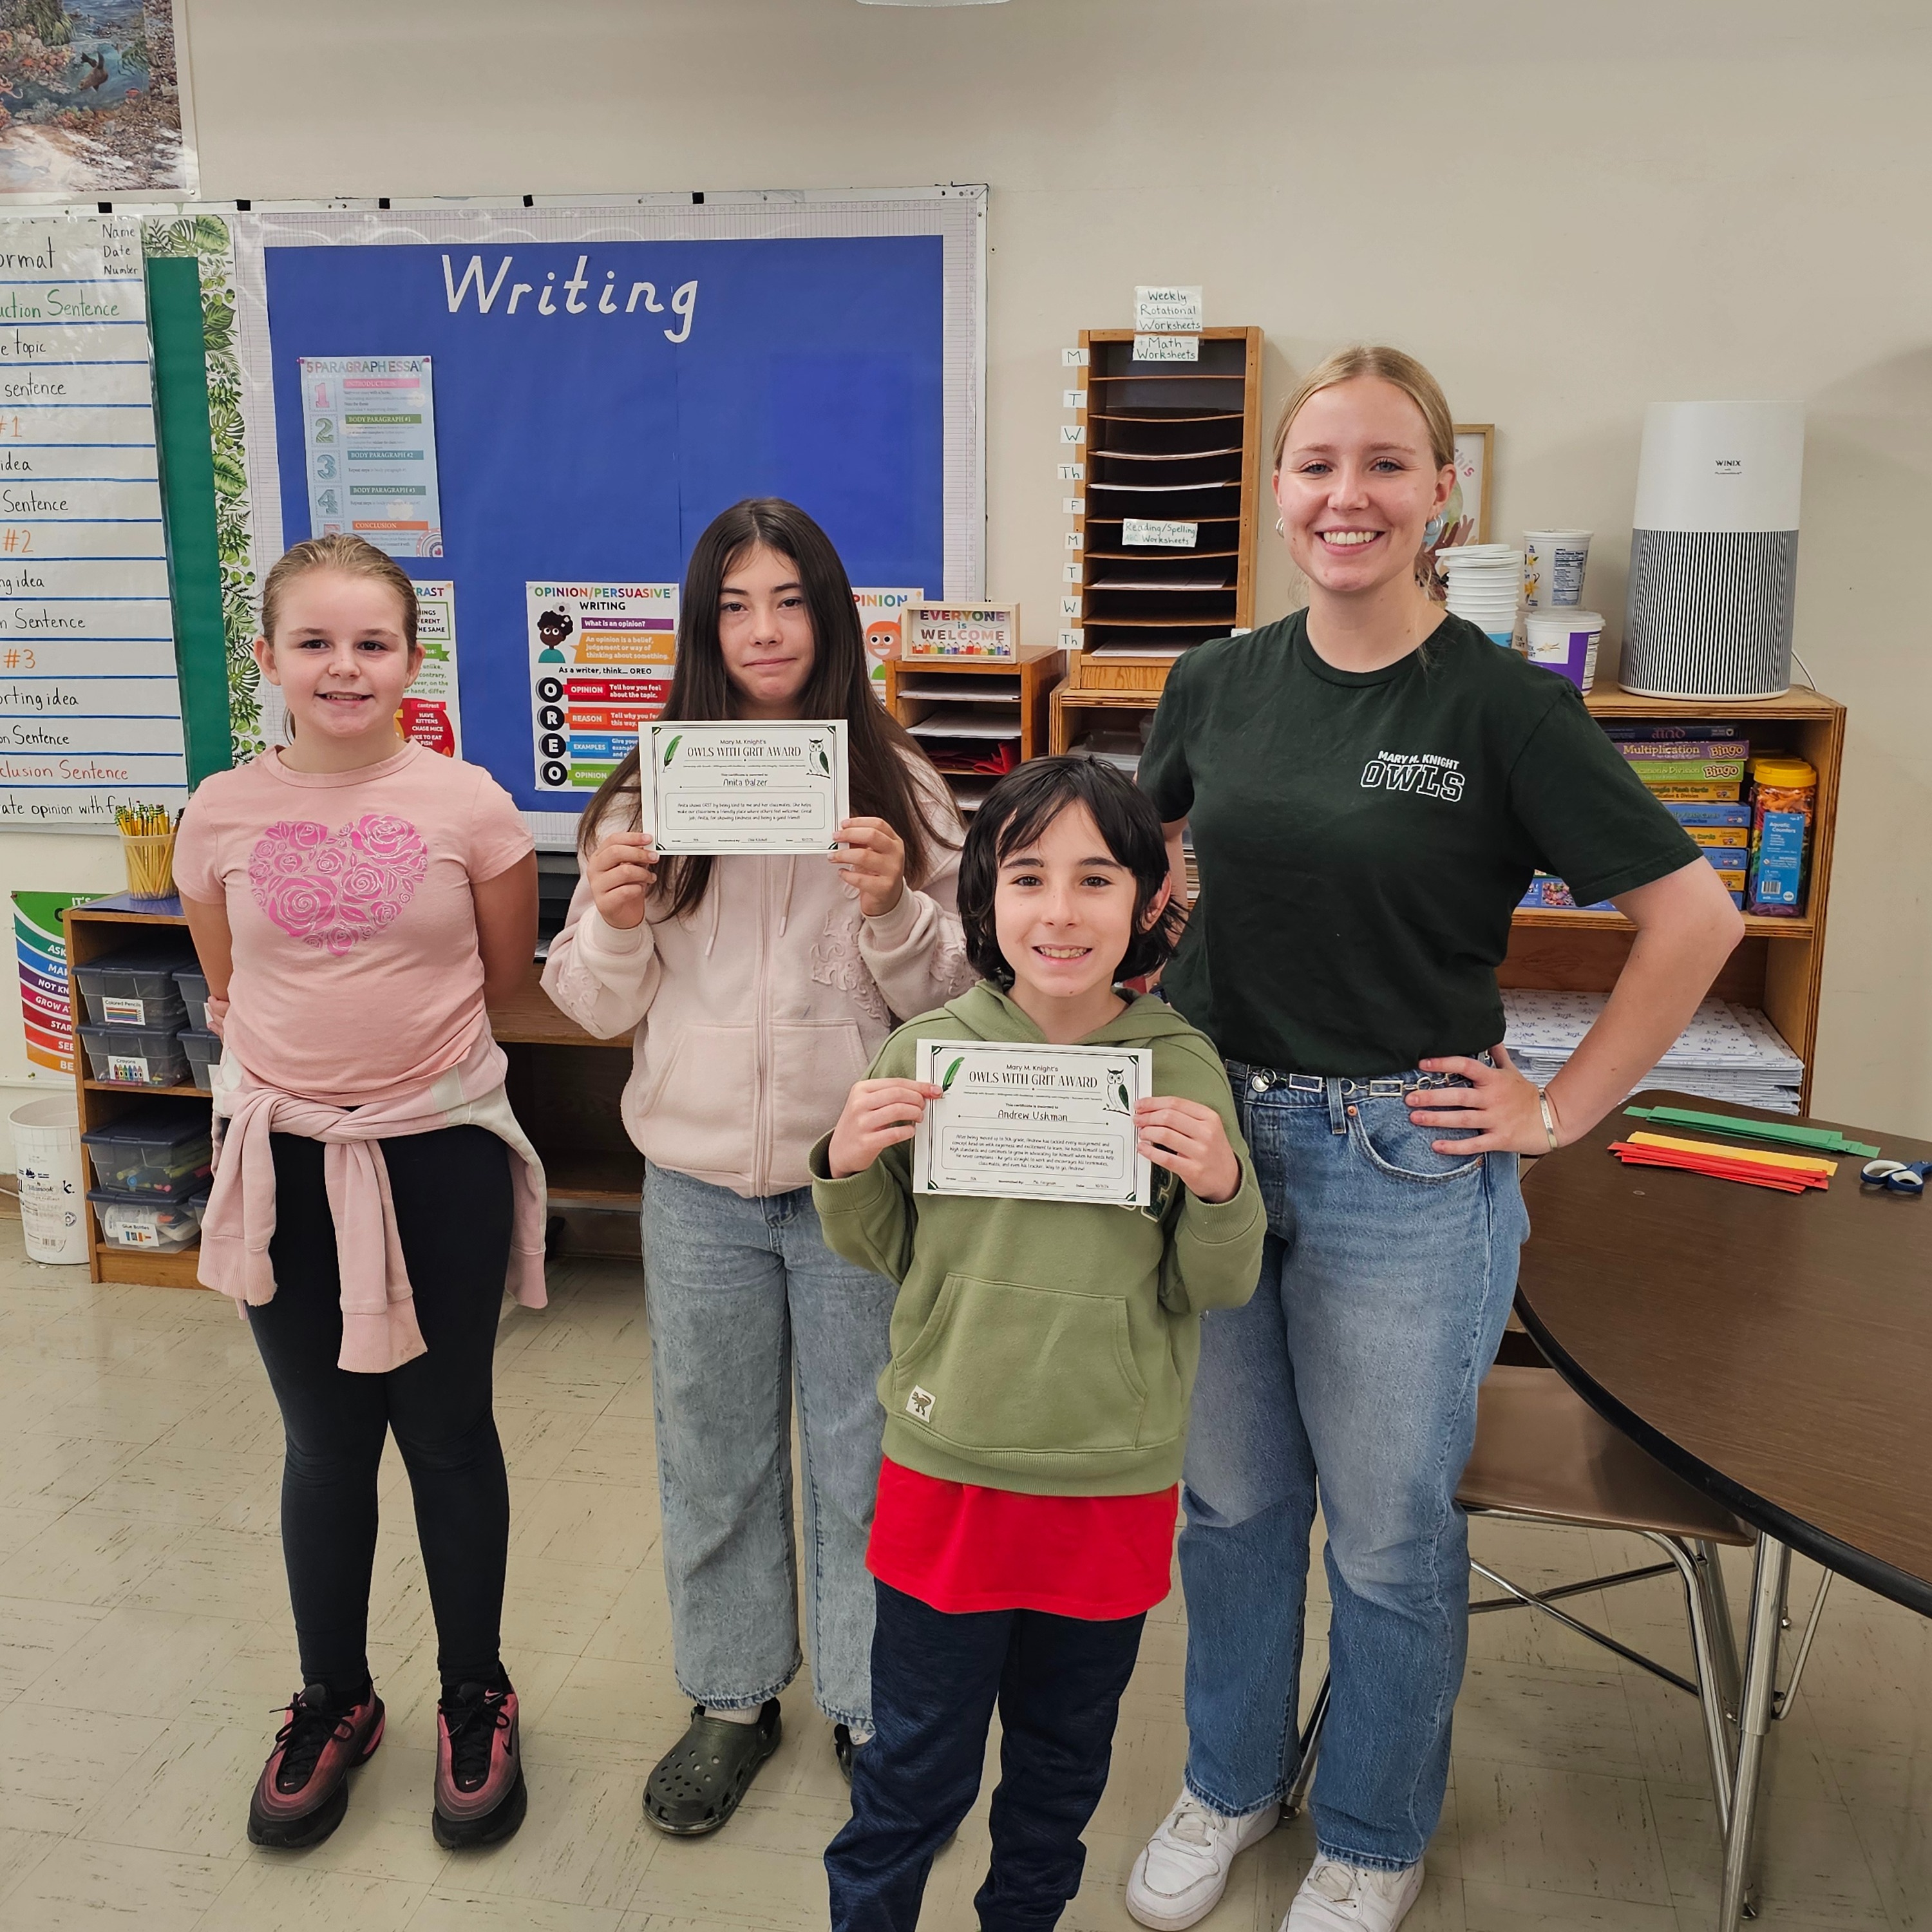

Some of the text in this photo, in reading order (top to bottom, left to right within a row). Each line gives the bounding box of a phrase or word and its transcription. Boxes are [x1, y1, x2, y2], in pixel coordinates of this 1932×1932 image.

[102, 223, 136, 238] Name
[104, 245, 131, 257] Date
[104, 264, 139, 276] Number
[47, 289, 120, 316] Sentence
[442, 254, 697, 343] Writing
[1148, 290, 1187, 305] Weekly
[1141, 304, 1196, 316] Rotational
[1139, 319, 1200, 330] Worksheets
[15, 328, 46, 358] topic
[1148, 337, 1182, 348] Math
[1067, 351, 1082, 363] M
[1137, 348, 1196, 359] Worksheets
[307, 361, 423, 373] 5 PARAGRAPH ESSAY
[5, 372, 67, 397] sentence
[1068, 393, 1081, 406] T
[315, 418, 334, 444] 2
[1064, 427, 1081, 441] W
[1, 451, 33, 471] idea
[317, 454, 337, 479] 3
[1059, 466, 1080, 479] Th
[3, 489, 69, 513] Sentence
[317, 489, 338, 515] 4
[1071, 500, 1079, 511] F
[1126, 521, 1196, 538] Reading/Spelling
[3, 528, 33, 553] #2
[1068, 535, 1078, 545] M
[1142, 535, 1189, 545] Worksheets
[15, 569, 44, 587] idea
[1066, 567, 1076, 578] T
[413, 587, 444, 596] RAST
[535, 587, 670, 600] OPINION/PERSUASIVE
[580, 601, 625, 611] WRITING
[1063, 600, 1077, 613] W
[15, 607, 86, 629] Sentence
[920, 610, 1005, 621] EVERYONE
[921, 629, 1004, 641] WELCOME
[1061, 634, 1078, 645] Th
[3, 649, 35, 668] #3
[46, 687, 79, 706] idea
[544, 683, 557, 697] O
[547, 711, 558, 724] R
[12, 725, 70, 744] Sentence
[549, 739, 558, 752] E
[687, 746, 801, 757] OWLS WITH GRIT AWARD
[1623, 745, 1744, 758] Multiplication Bingo
[1378, 750, 1459, 770] MARY M. KNIGHT
[59, 759, 129, 780] Sentence
[549, 766, 561, 780] O
[1703, 765, 1739, 778] Bingo
[723, 778, 742, 786] Anita
[1360, 760, 1465, 802] OWLS
[32, 804, 73, 818] opinion
[79, 795, 104, 815] with
[48, 945, 67, 956] ASK
[38, 979, 56, 990] NOT
[35, 996, 61, 1009] GROW
[969, 1071, 1097, 1088] OWLS WITH GRIT AWARD
[998, 1110, 1068, 1122] Andrew Ushman
